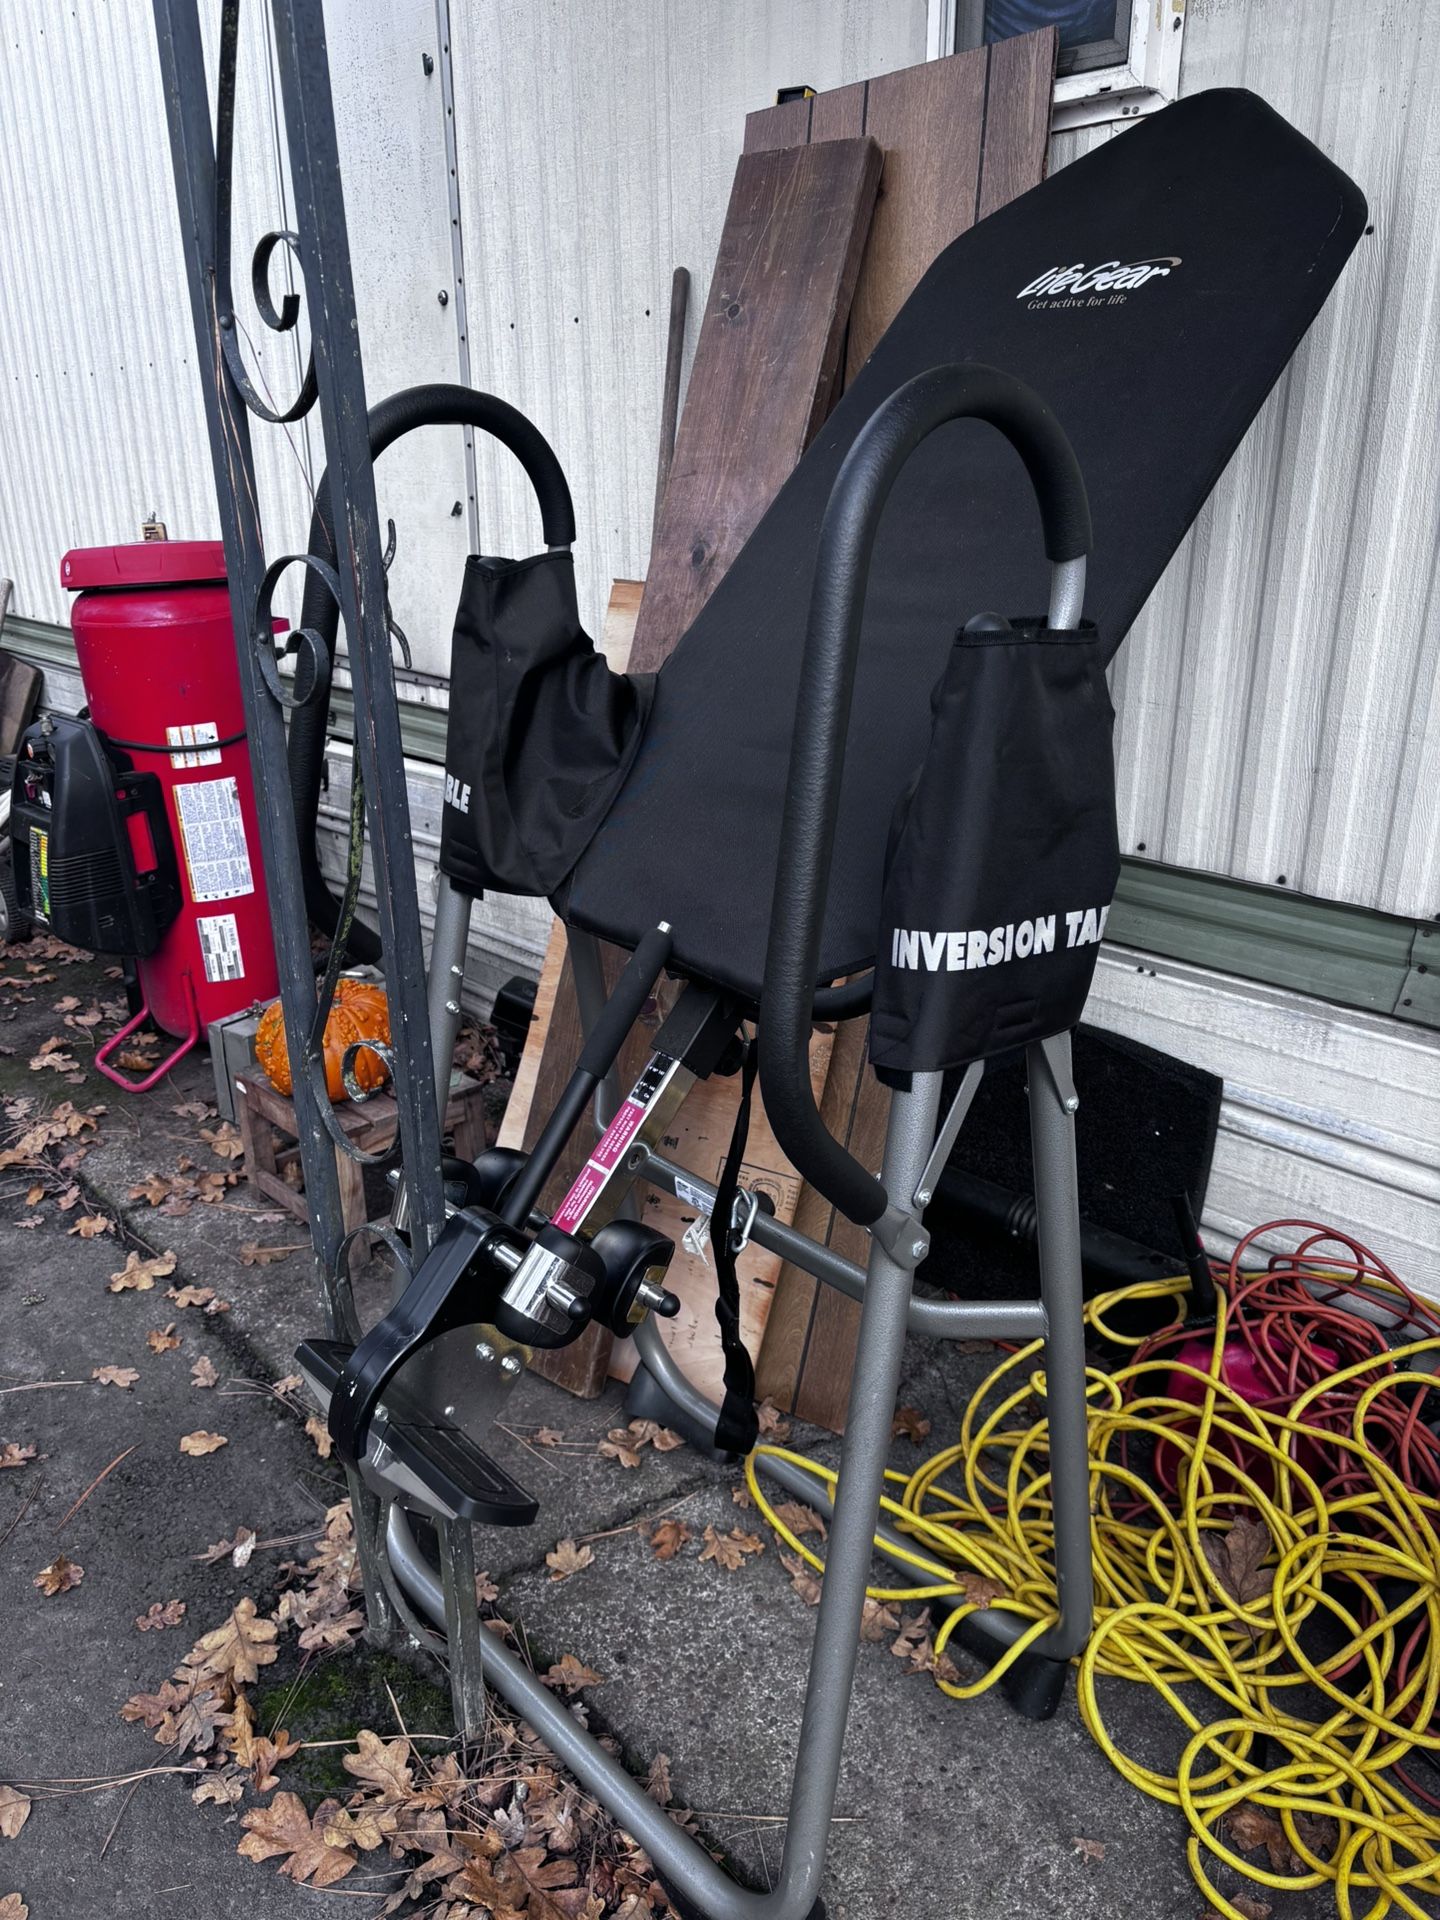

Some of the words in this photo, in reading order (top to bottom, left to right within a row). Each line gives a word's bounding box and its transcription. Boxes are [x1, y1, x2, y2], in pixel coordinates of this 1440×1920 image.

[1016, 259, 1172, 299] LifeGear
[1027, 299, 1047, 310] Get
[1050, 297, 1085, 309] active
[1086, 296, 1106, 308] for
[1107, 294, 1127, 305] life
[891, 914, 1056, 972] INVERSION
[611, 1119, 634, 1153] WARNING
